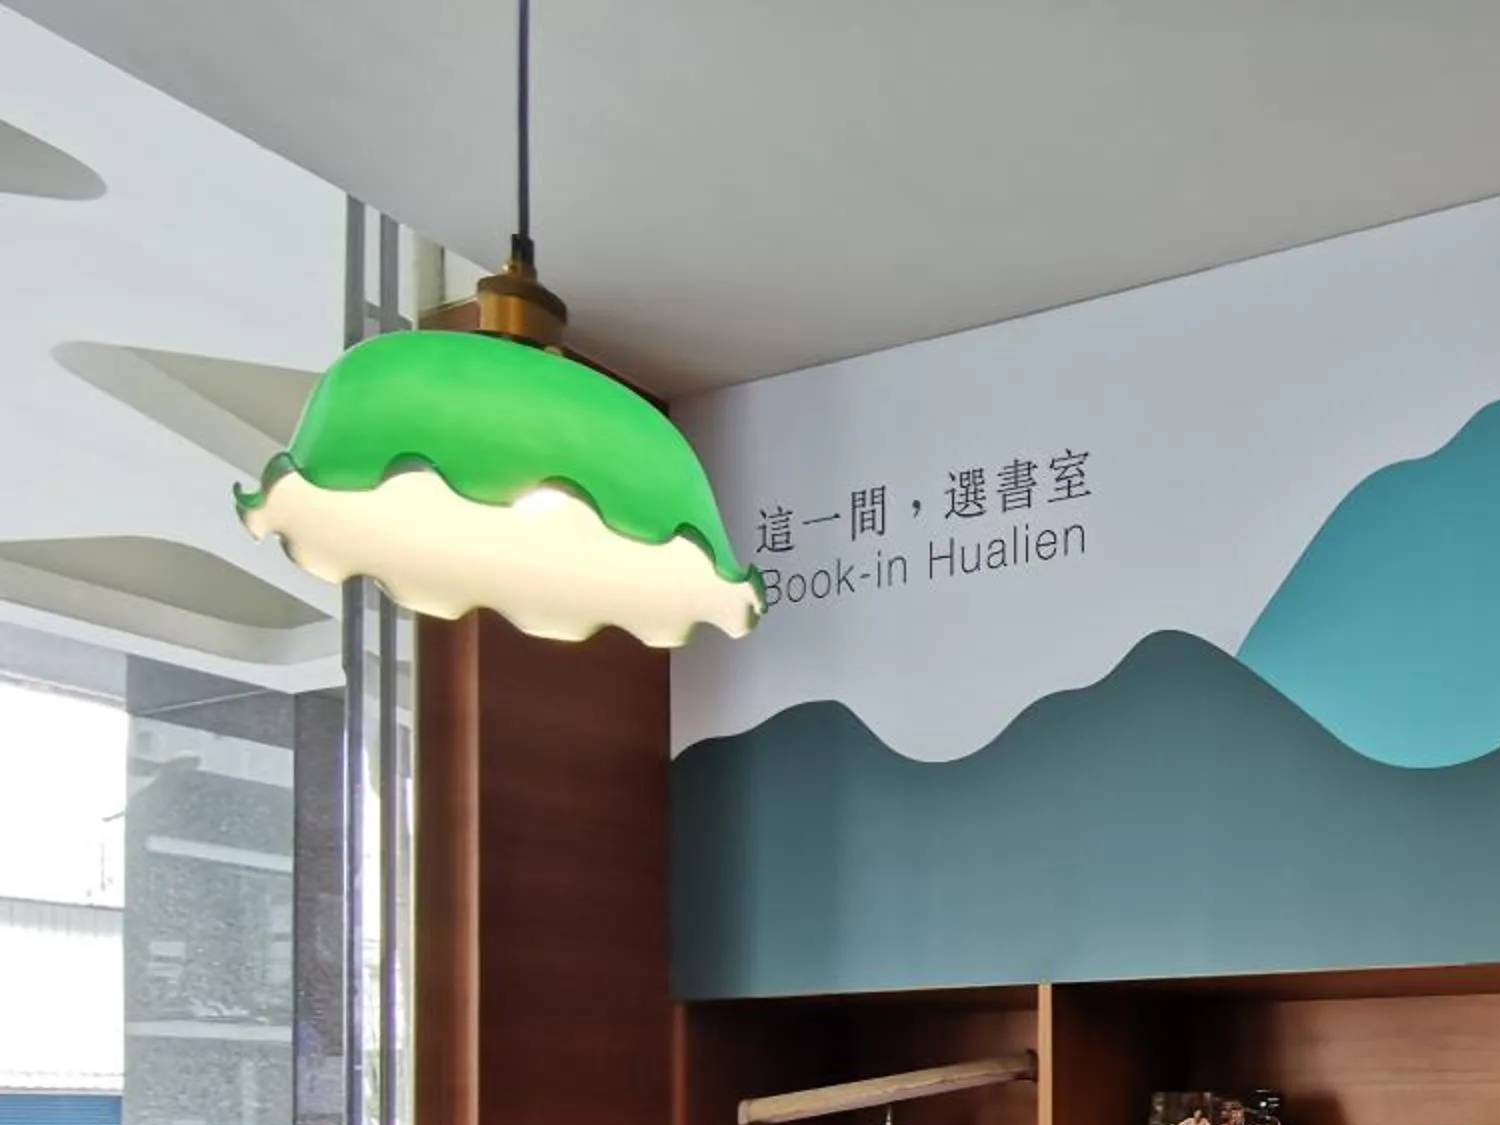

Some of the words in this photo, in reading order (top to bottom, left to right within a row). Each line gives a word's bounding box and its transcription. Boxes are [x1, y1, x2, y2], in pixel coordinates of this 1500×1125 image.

[756, 449, 1092, 554] 這一間，選書室
[764, 551, 907, 606] Book-in
[929, 522, 1086, 580] Hualien
